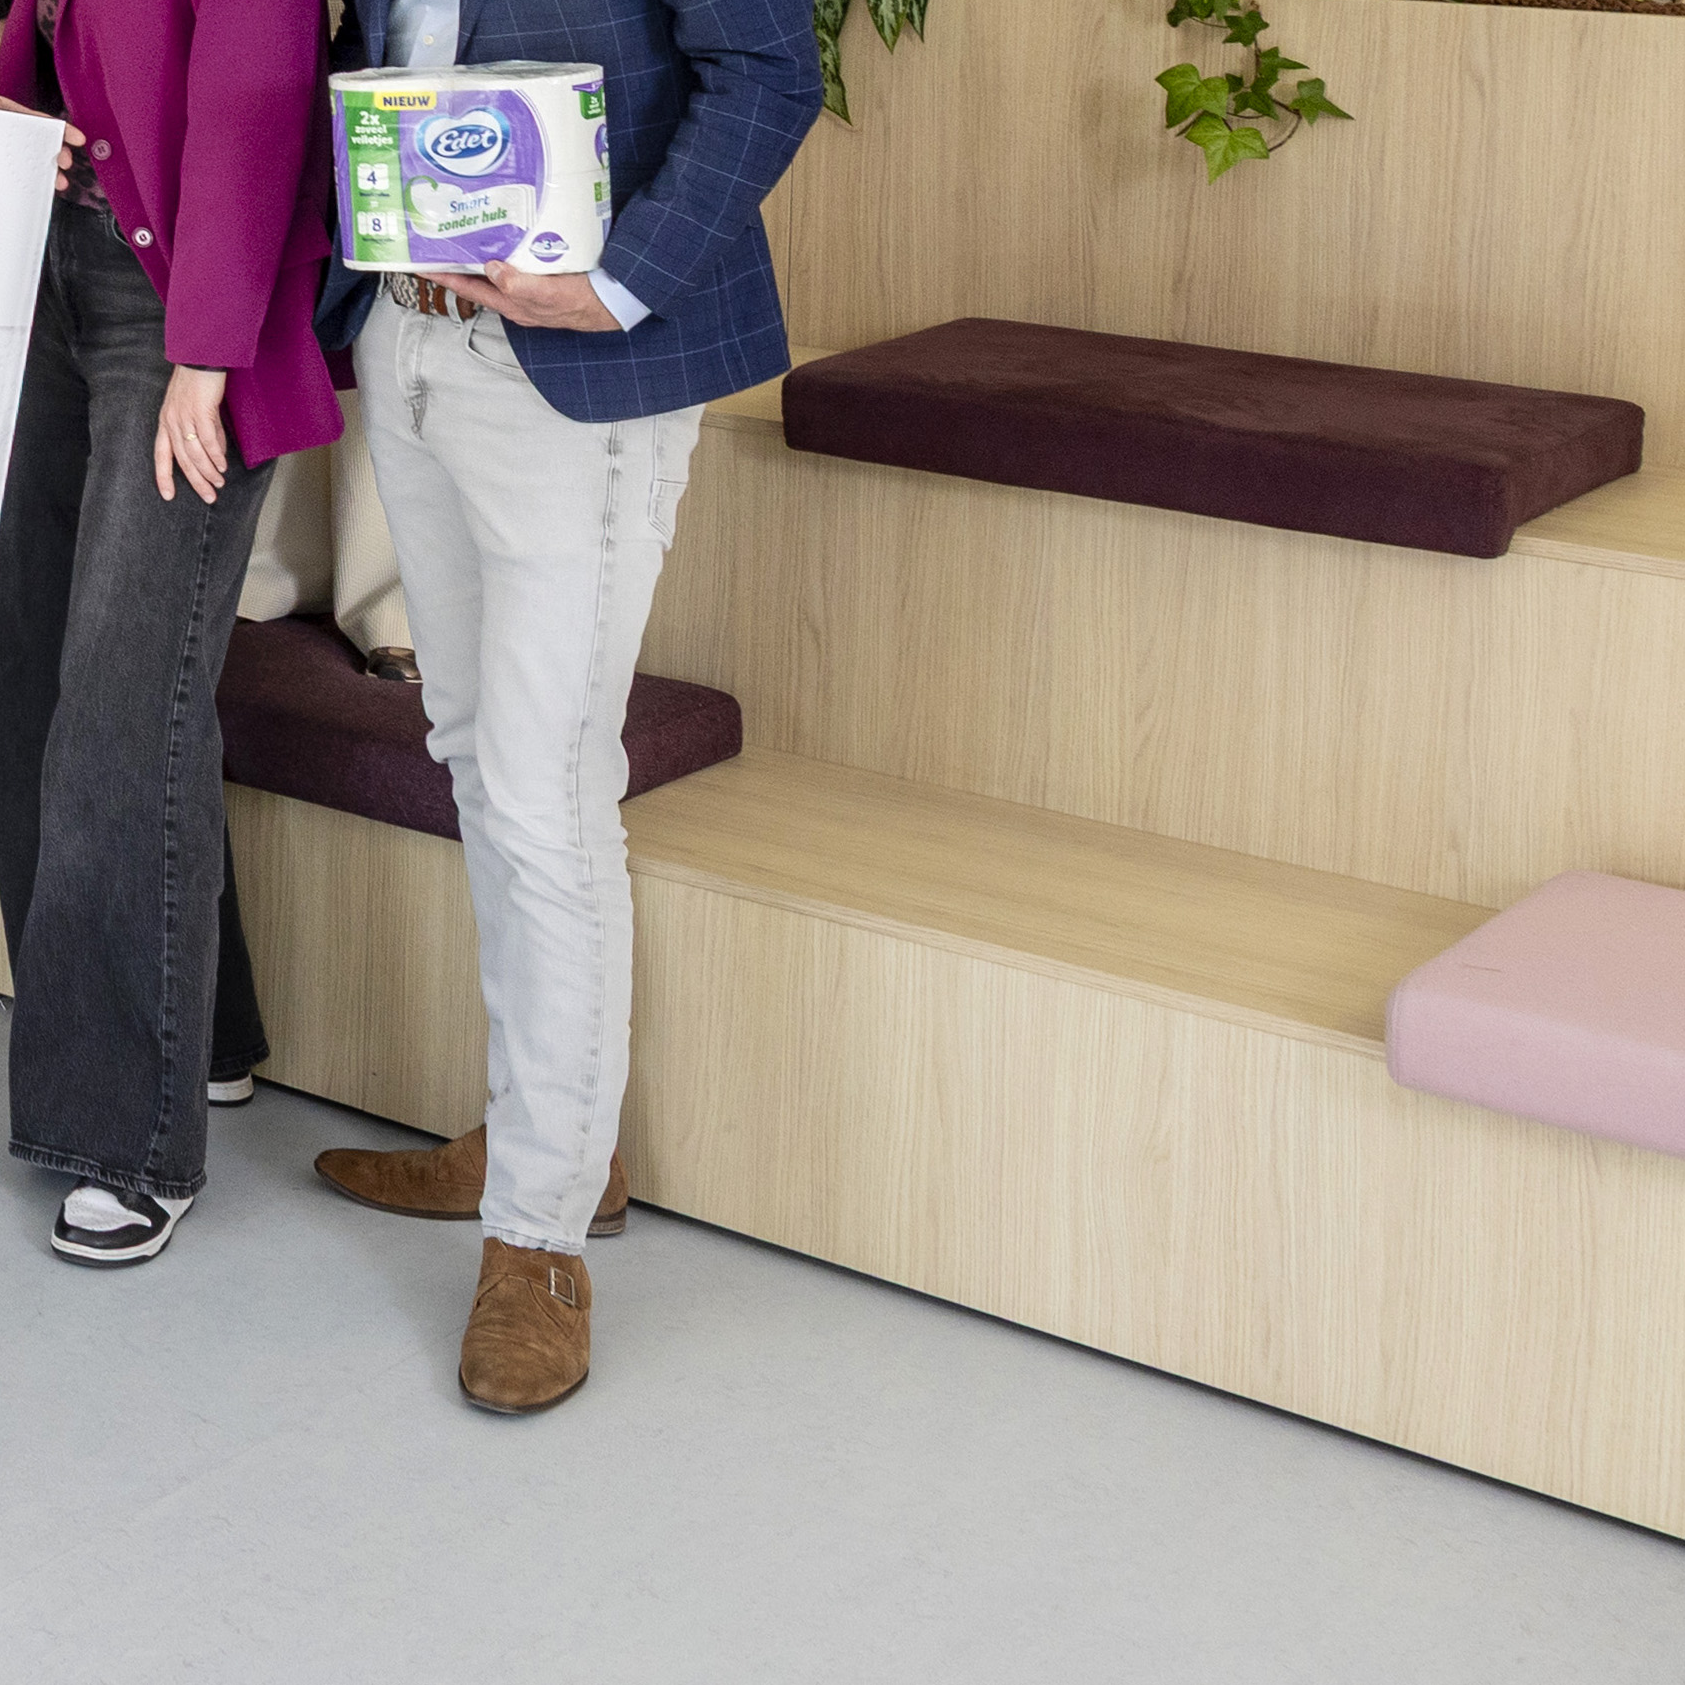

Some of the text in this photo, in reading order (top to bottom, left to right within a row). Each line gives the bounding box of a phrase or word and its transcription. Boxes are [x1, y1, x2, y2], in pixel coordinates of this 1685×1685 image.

[382, 96, 431, 107] NIEUW
[359, 111, 380, 125] 2x
[350, 135, 394, 147] velletjes
[436, 129, 494, 157] Edet
[367, 171, 377, 185] 4
[449, 195, 491, 214] Smart
[372, 217, 382, 232] 8
[437, 207, 508, 233] zonder huls
[544, 239, 552, 250] 3
